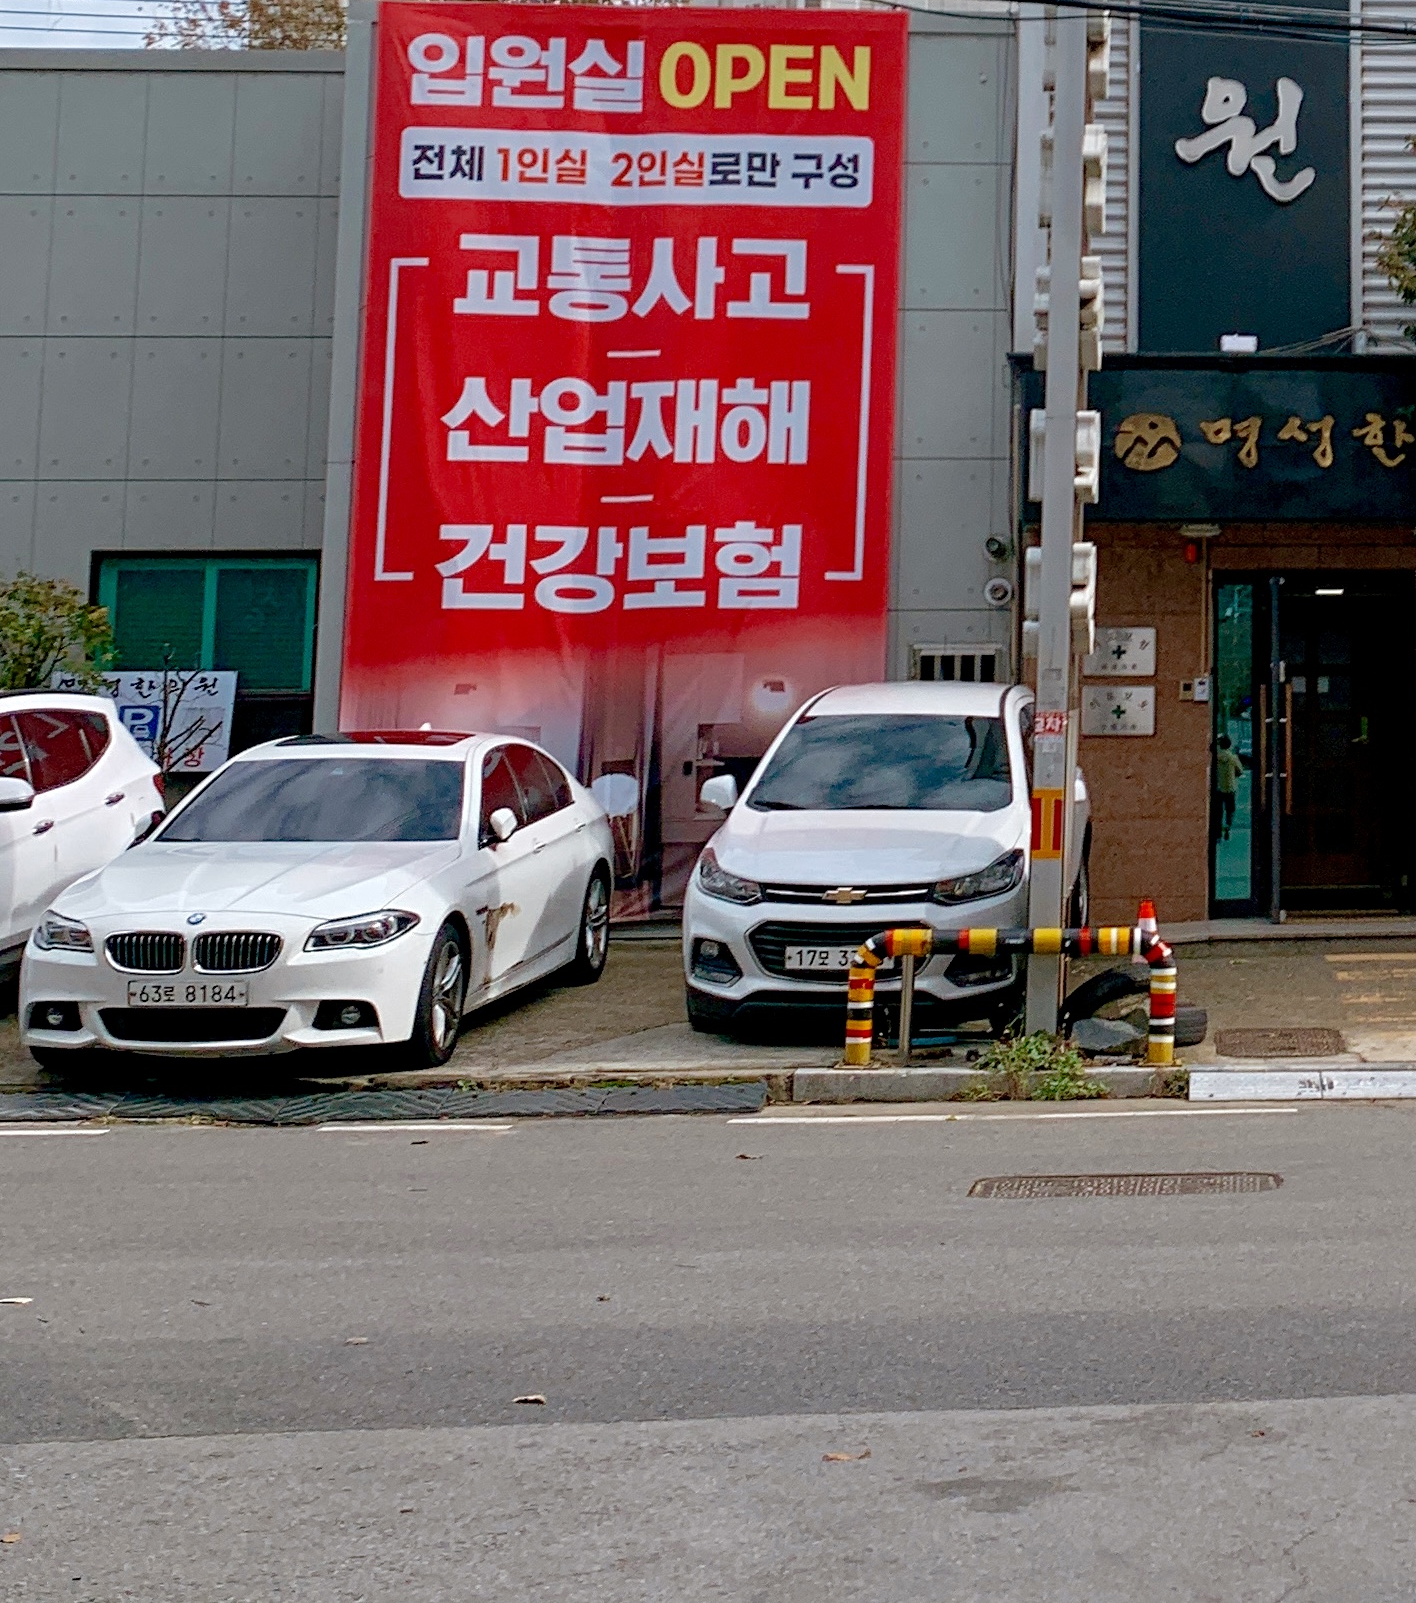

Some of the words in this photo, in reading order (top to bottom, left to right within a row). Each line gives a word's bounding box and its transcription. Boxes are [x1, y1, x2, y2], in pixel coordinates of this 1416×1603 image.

[407, 32, 645, 112] 입원실
[659, 42, 871, 112] OPEN
[411, 142, 485, 184] 전체
[497, 146, 588, 186] 1인실
[611, 150, 780, 189] 2인실로만
[790, 153, 860, 190] 구성
[453, 233, 811, 321] 교통사고
[441, 376, 808, 466] 산업재해
[435, 520, 802, 615] 건강보험
[139, 985, 175, 1003] 63로
[185, 985, 236, 1003] 8184
